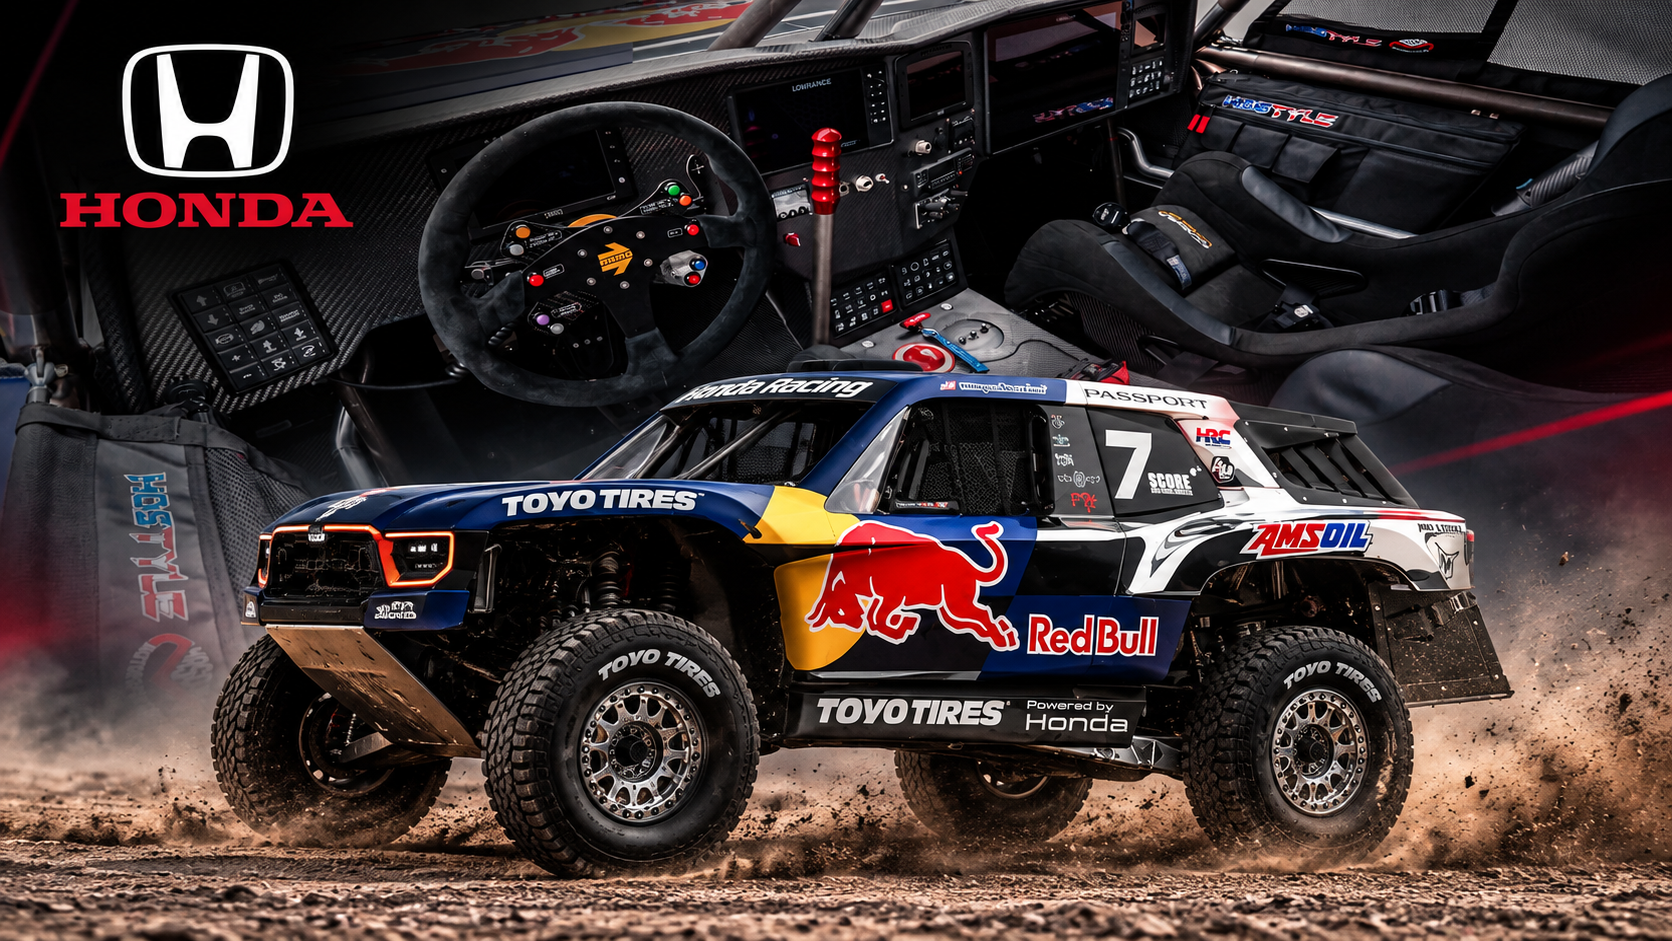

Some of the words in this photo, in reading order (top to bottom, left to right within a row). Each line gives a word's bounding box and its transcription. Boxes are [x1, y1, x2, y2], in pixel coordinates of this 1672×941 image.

[674, 379, 765, 403] Honda
[760, 377, 873, 398] Racing
[1084, 388, 1207, 409] PASSPORT
[1195, 427, 1231, 445] HRC
[1105, 429, 1152, 500] 7
[1147, 472, 1192, 490] SCORE
[502, 489, 596, 517] TOYO
[599, 489, 698, 511] TIRES
[1247, 522, 1370, 557] AMSOIL
[1027, 614, 1094, 656] Red
[1094, 616, 1160, 657] Bull
[598, 648, 661, 681] TOYO
[664, 651, 721, 698] TIRES
[1283, 660, 1332, 690] TOYO
[1335, 661, 1382, 703] TIRES
[817, 698, 909, 725] TOYO
[911, 700, 1004, 726] TIRES
[1026, 700, 1092, 711] Powered
[1096, 700, 1114, 714] by
[1025, 713, 1129, 733] Honda
